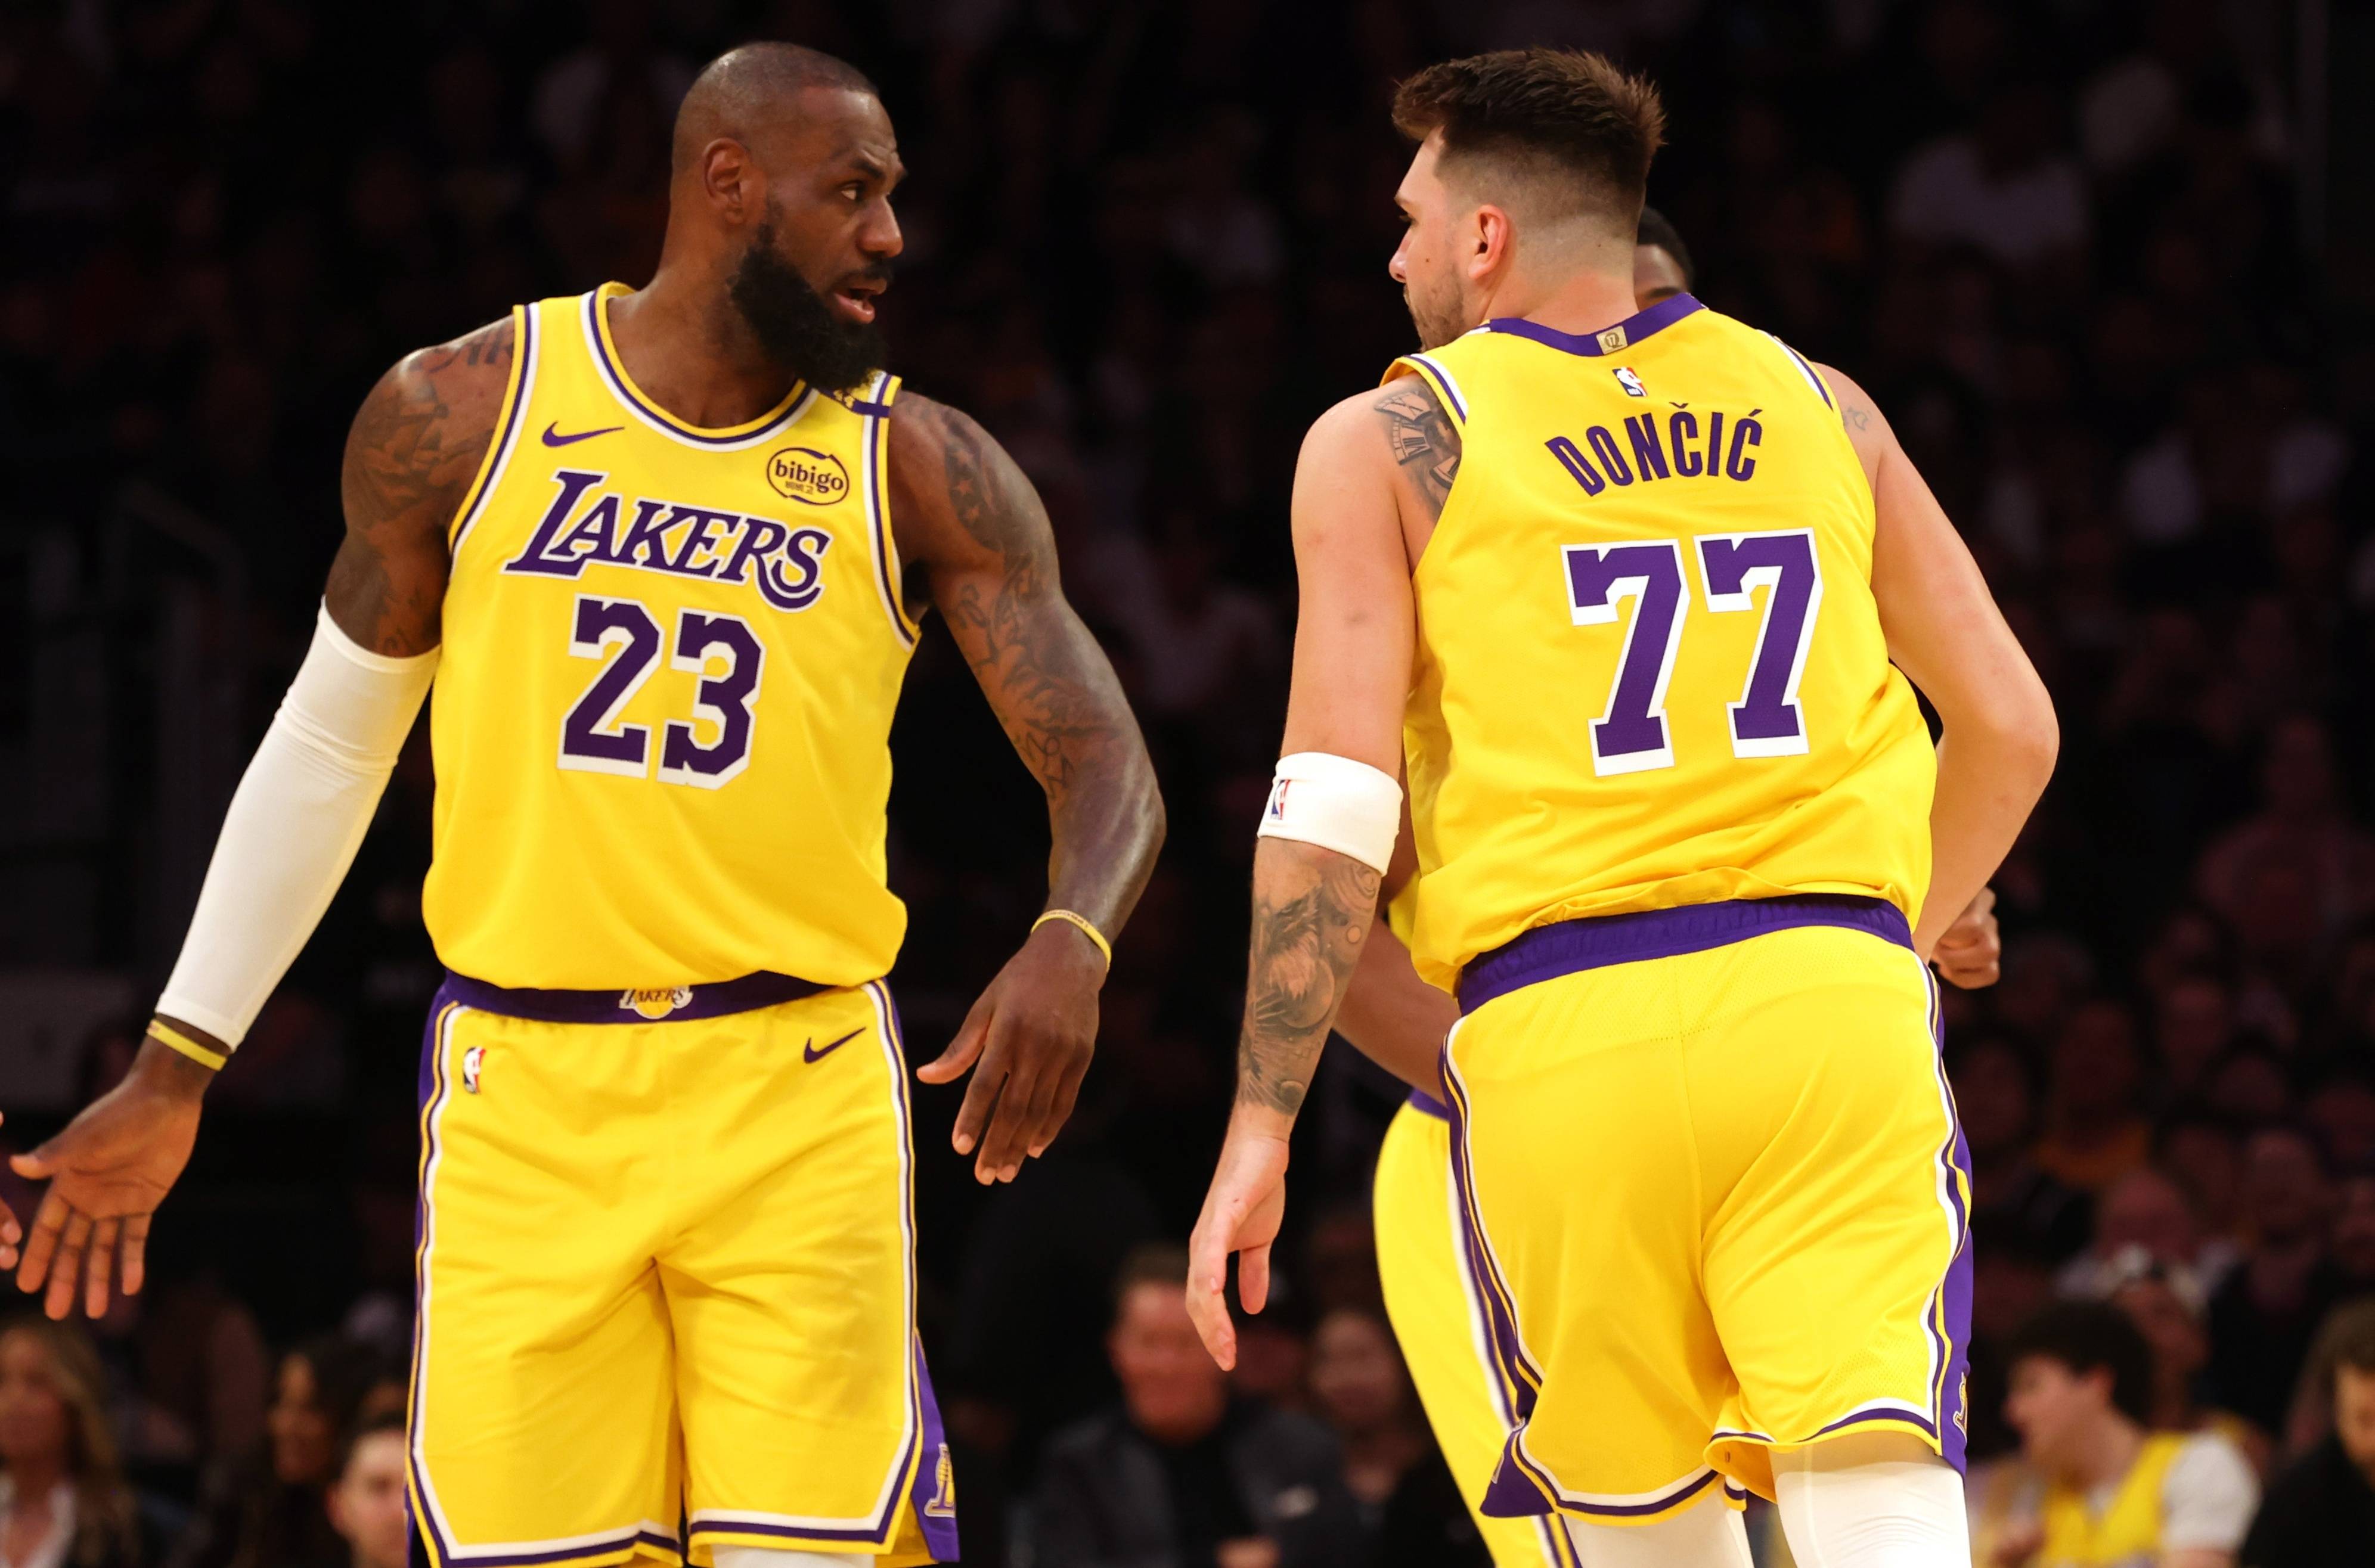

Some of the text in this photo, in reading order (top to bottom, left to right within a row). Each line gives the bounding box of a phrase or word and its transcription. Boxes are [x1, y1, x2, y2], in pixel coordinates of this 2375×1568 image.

[775, 459, 844, 493] bibigo
[1544, 402, 1763, 497] DONČIĆ
[501, 467, 833, 613] LAKERS
[557, 593, 766, 790] 23
[1560, 527, 1824, 777] 77
